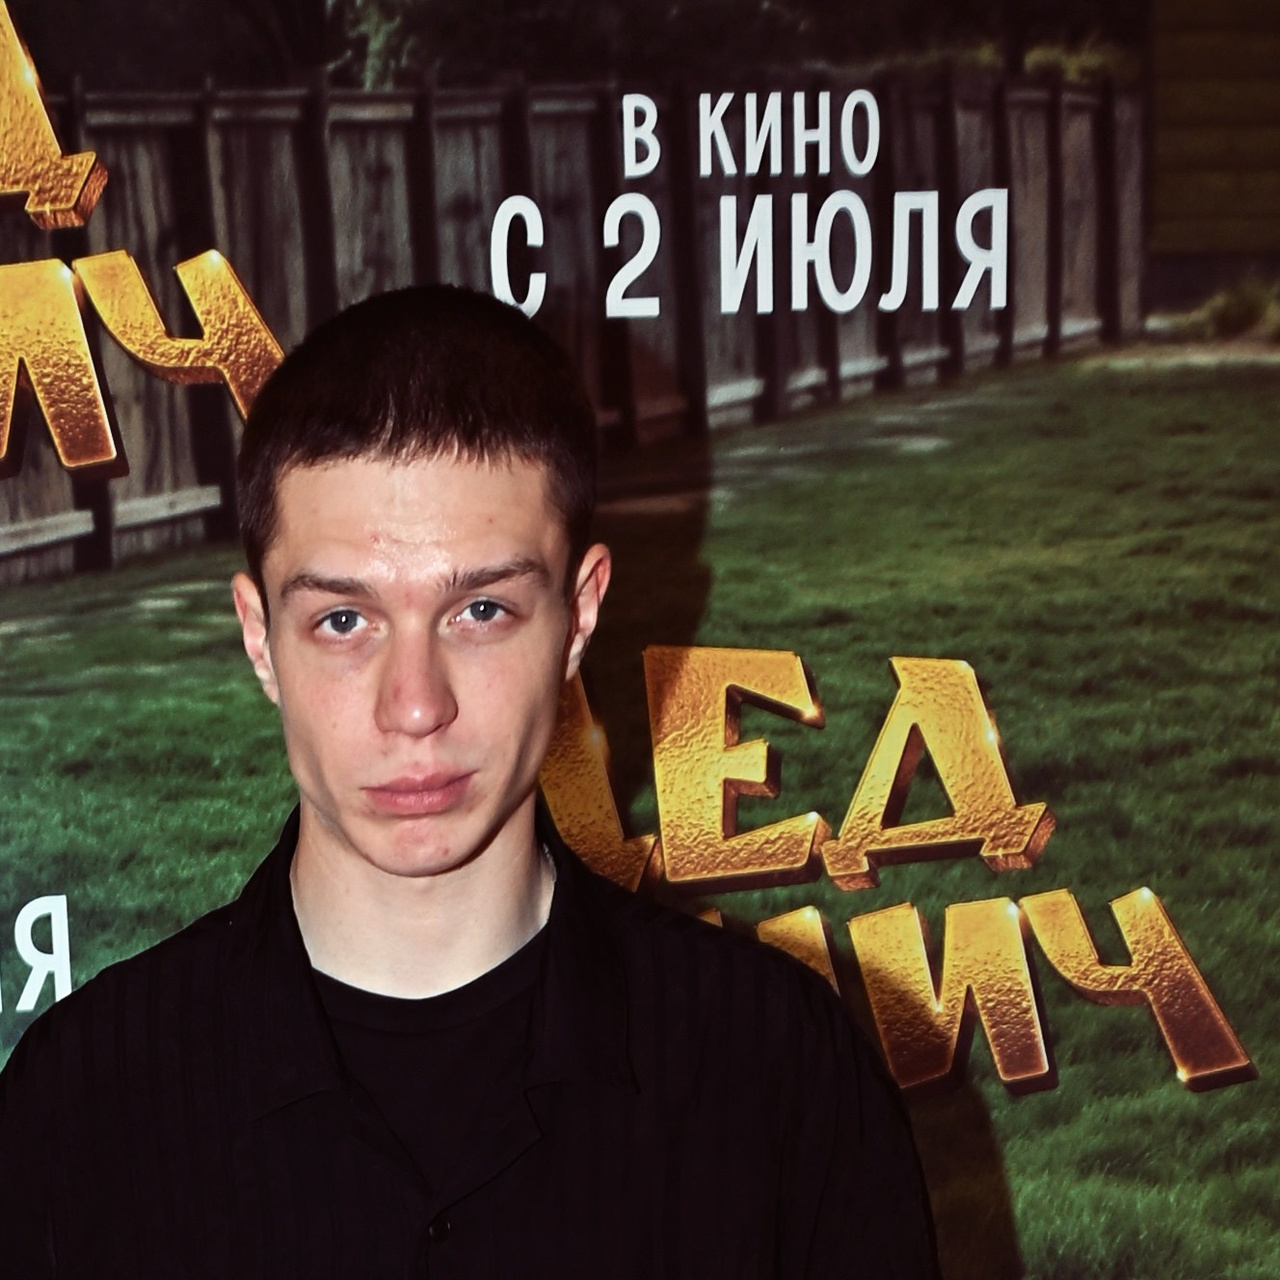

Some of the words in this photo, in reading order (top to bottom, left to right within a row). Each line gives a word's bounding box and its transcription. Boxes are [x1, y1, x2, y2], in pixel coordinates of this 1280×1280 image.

[622, 94, 662, 178] В
[698, 89, 881, 177] КИНО
[490, 195, 547, 320] С
[603, 193, 662, 319] 2
[719, 188, 1009, 314] ИЮЛЯ
